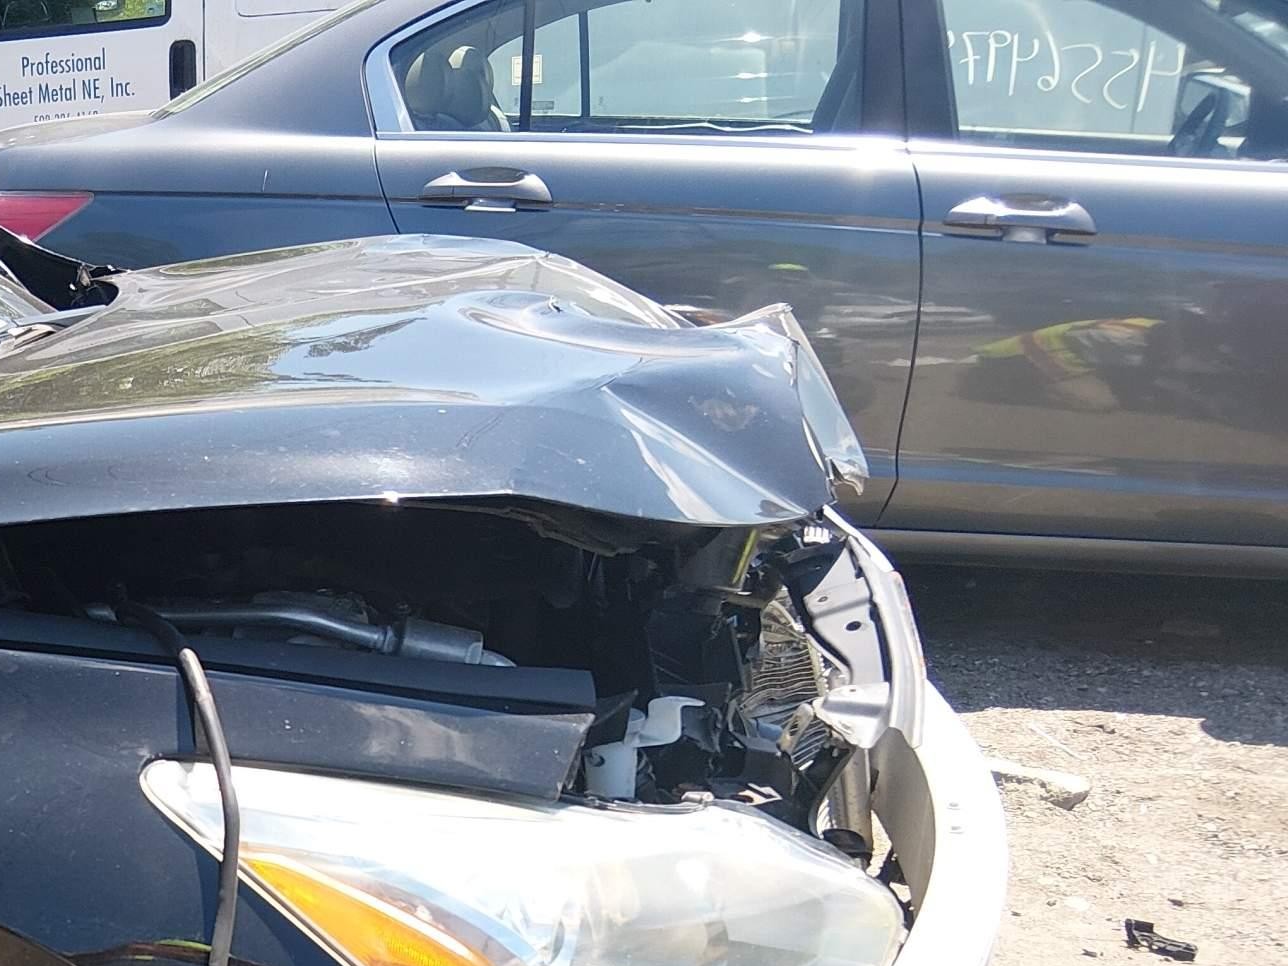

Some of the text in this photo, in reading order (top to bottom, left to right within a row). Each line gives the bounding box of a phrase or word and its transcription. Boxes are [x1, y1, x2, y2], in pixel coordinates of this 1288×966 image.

[22, 48, 105, 77] Professional
[39, 79, 76, 104] Metal
[82, 79, 104, 103] NE,
[111, 77, 134, 97] Inc.
